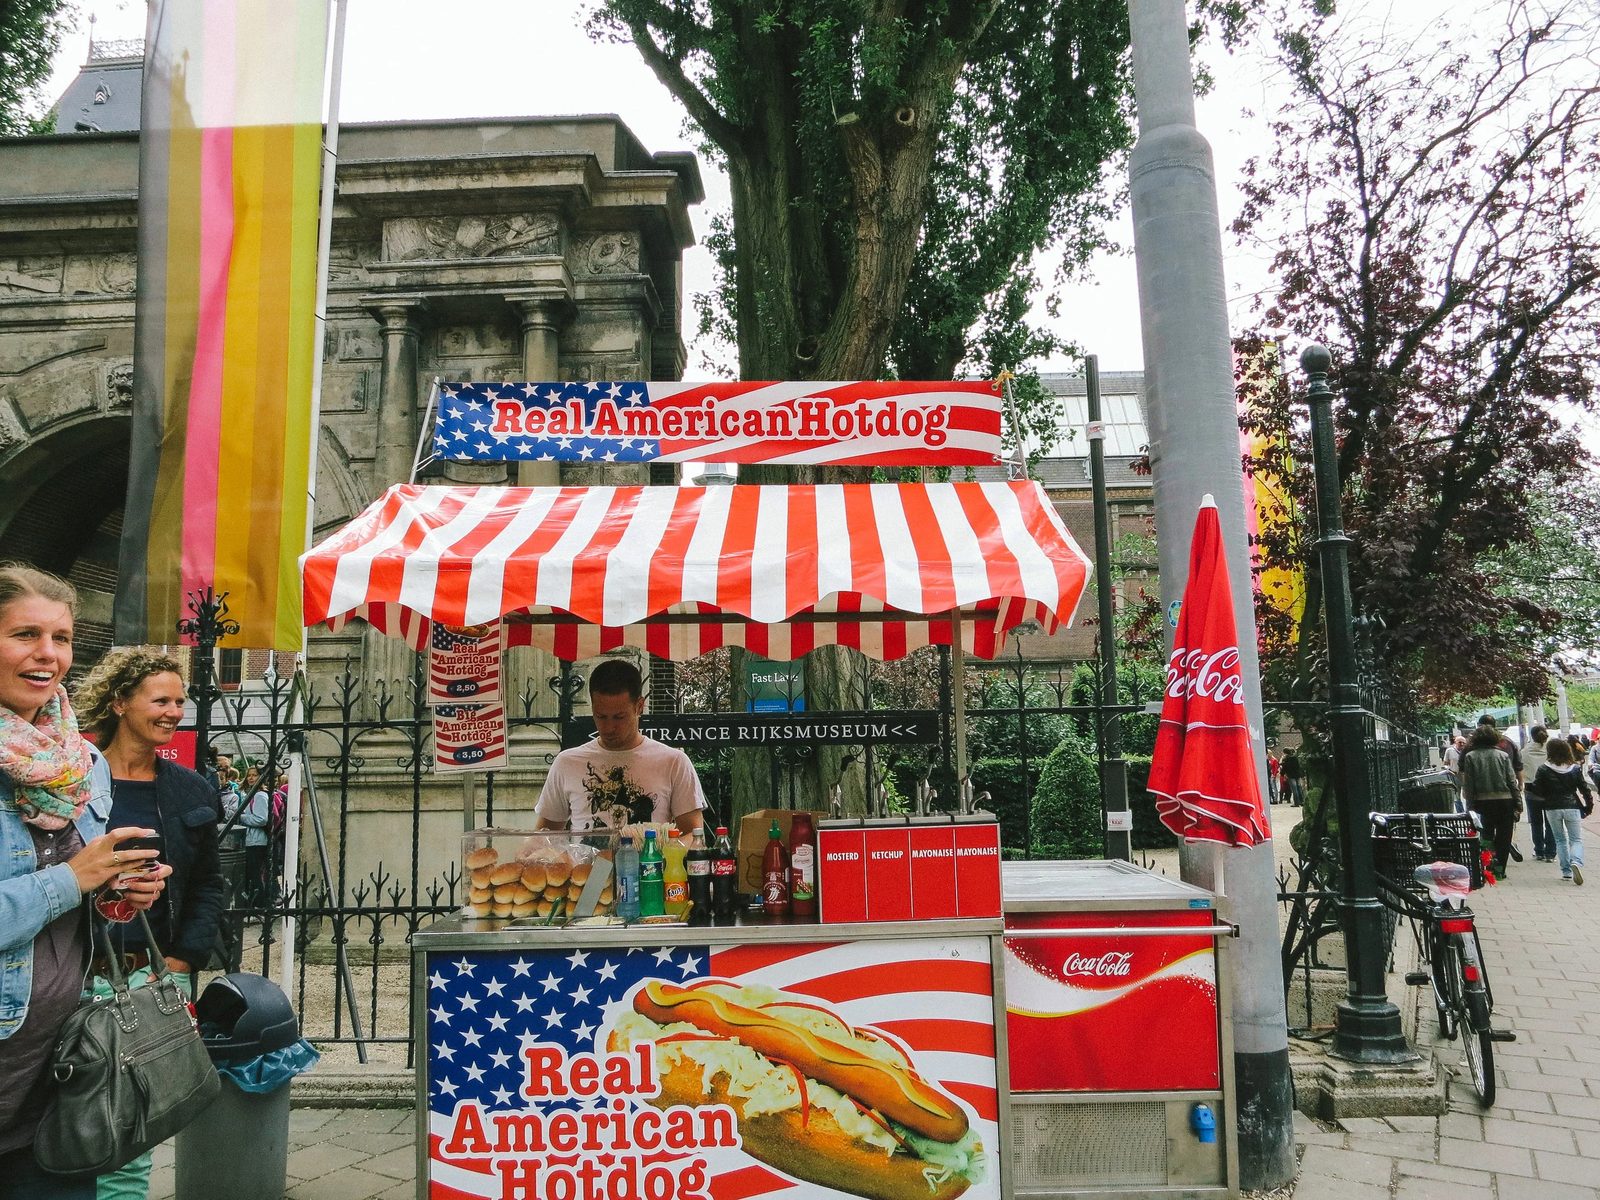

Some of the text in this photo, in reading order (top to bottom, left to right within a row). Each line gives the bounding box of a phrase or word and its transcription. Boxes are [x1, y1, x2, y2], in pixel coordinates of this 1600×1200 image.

[493, 400, 947, 447] Real American Hotdog
[453, 643, 478, 654] Real
[437, 654, 493, 665] American
[446, 665, 487, 677] Hotdog
[751, 672, 773, 683] Fast
[456, 684, 476, 693] 2,50
[456, 709, 477, 722] Big
[442, 720, 497, 732] American
[452, 730, 493, 743] Hotdog
[639, 724, 888, 743] TRANCE RIJKSMUSEUM
[462, 750, 483, 760] 3,50
[826, 852, 859, 861] MOSTERD
[871, 851, 904, 859] KETCHUP
[912, 849, 954, 858] MAYONAISE
[956, 847, 998, 856] MAYONAISE
[1062, 952, 1134, 976] Coca-Cola
[525, 1044, 656, 1097] Real
[445, 1098, 737, 1154] American
[496, 1155, 708, 1200] Hotdog
